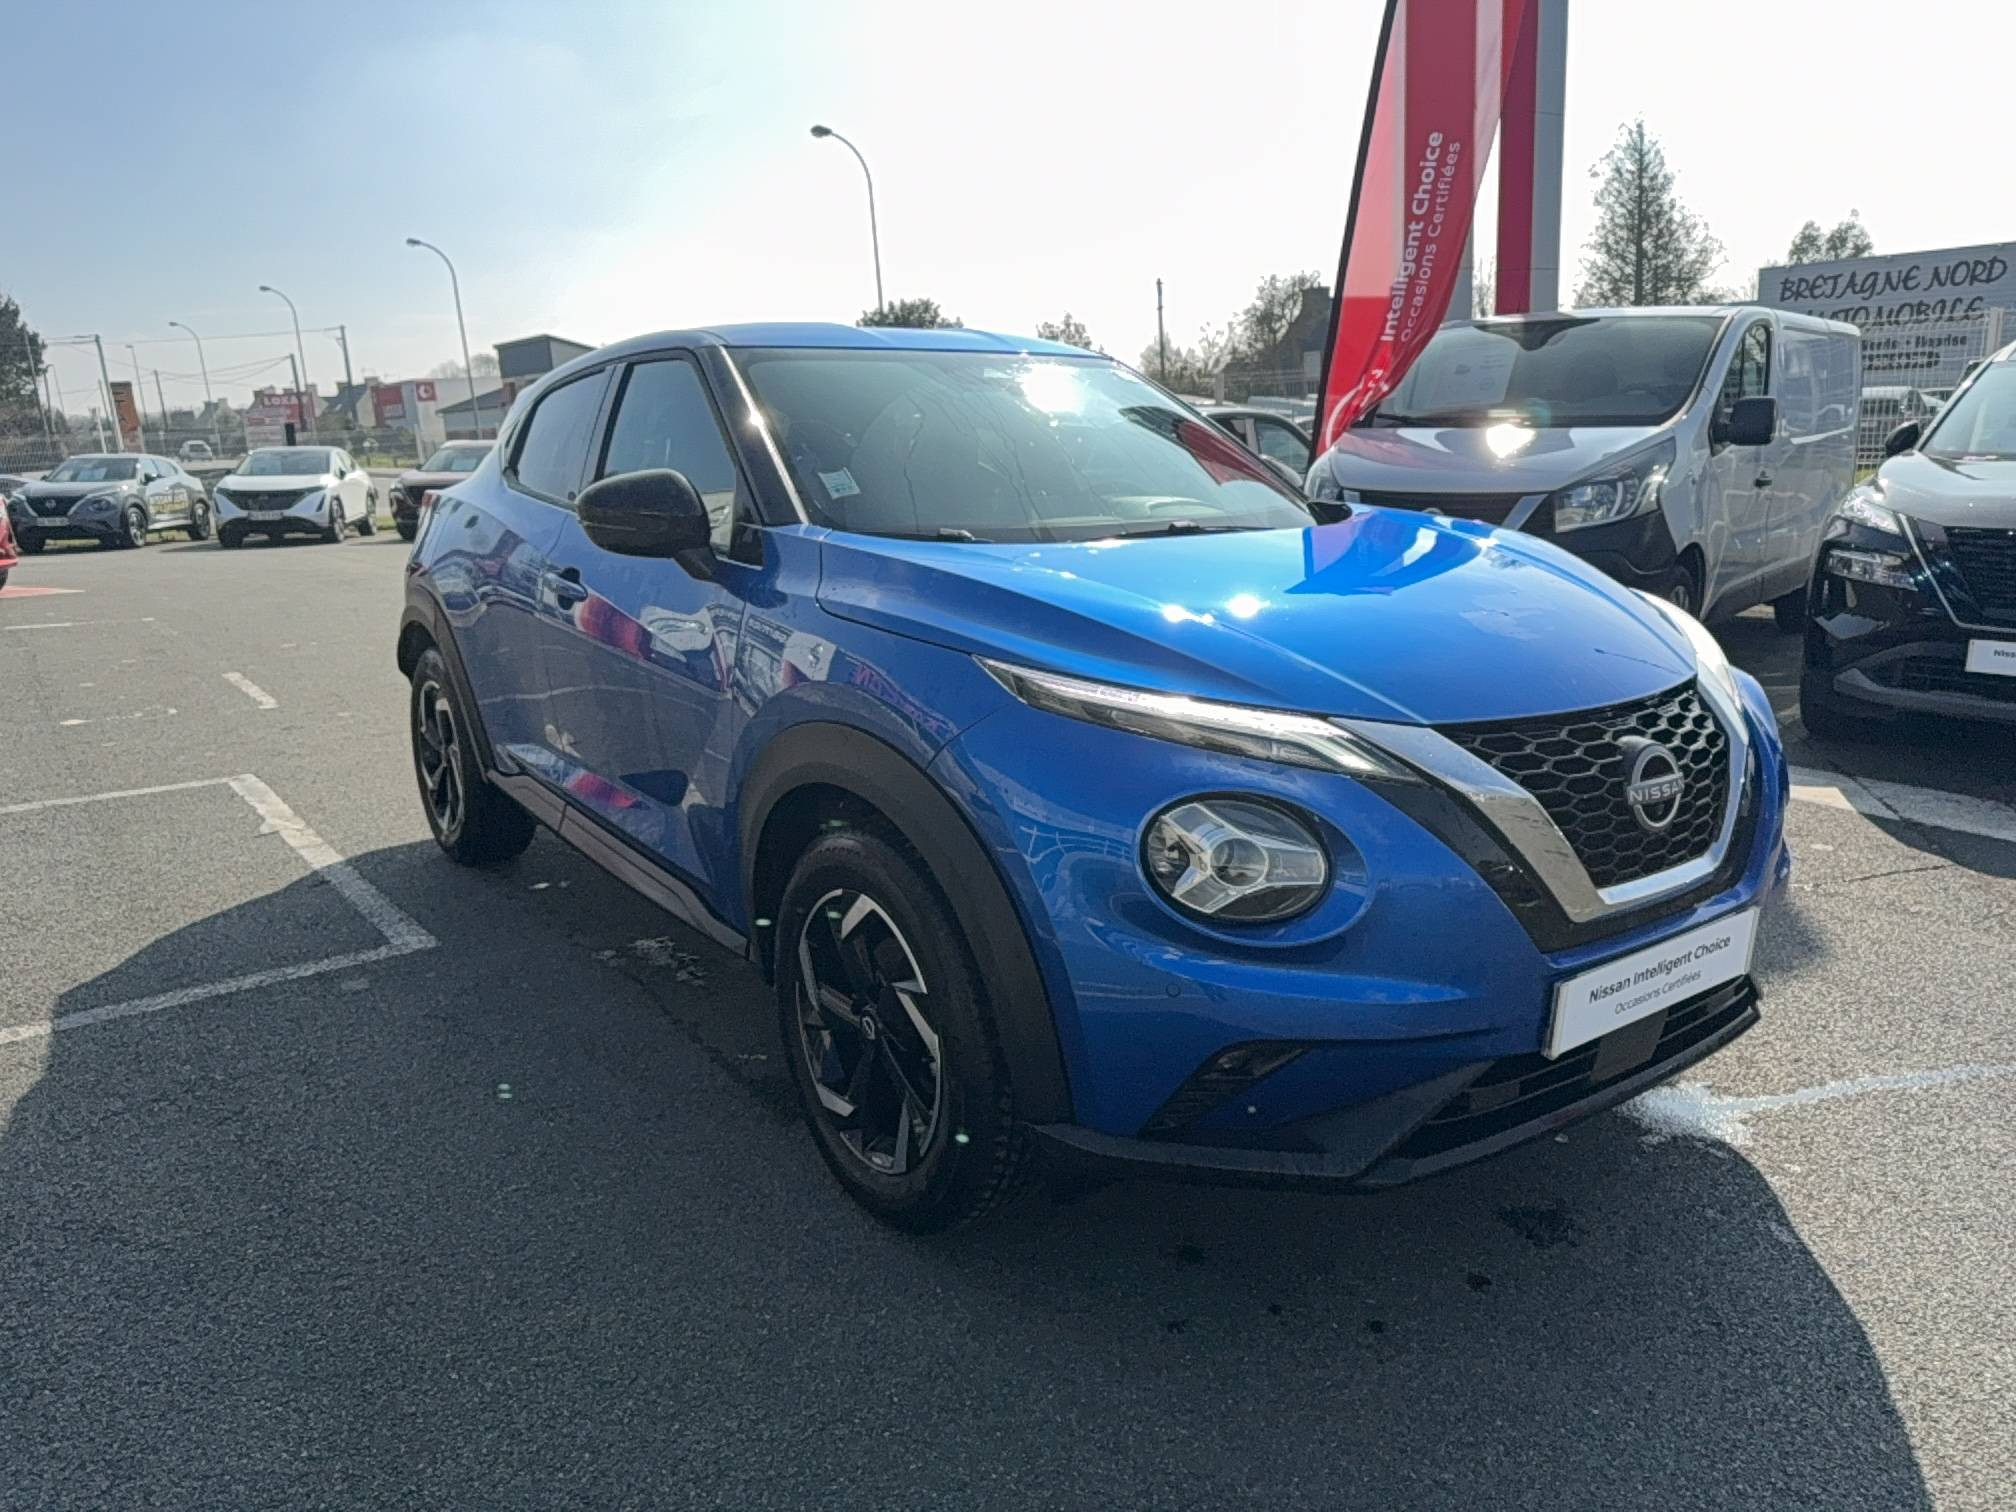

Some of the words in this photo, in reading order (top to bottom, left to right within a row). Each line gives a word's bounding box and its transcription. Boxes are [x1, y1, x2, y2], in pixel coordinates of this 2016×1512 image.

[1428, 142, 1461, 237] Certifiées
[1381, 221, 1424, 341] Intelligent
[1412, 131, 1443, 215] Choice
[1779, 264, 1921, 302] BRETAGNE
[1923, 256, 2008, 292] NORD
[1629, 778, 1685, 803] NISSAN
[1589, 977, 1630, 1004] Nissan
[1633, 951, 1692, 986] Intelligent
[1694, 936, 1731, 960] Choice
[1614, 986, 1661, 1016] Occasions
[1661, 970, 1702, 995] Certifiées
